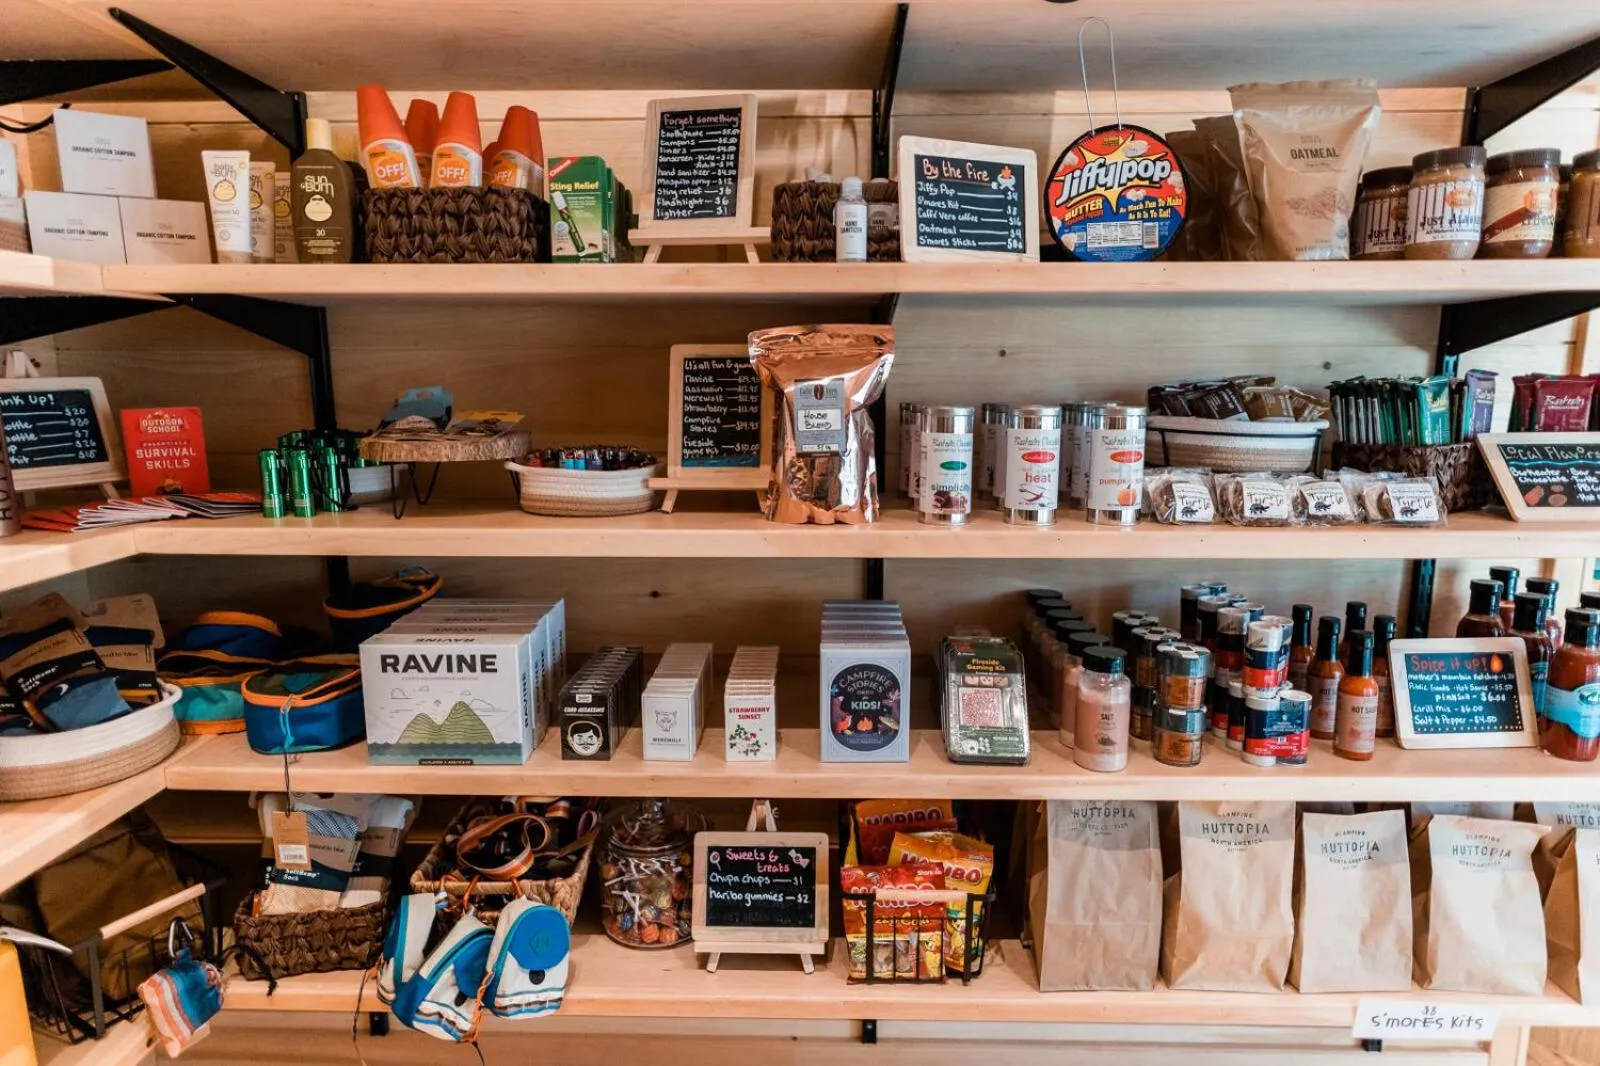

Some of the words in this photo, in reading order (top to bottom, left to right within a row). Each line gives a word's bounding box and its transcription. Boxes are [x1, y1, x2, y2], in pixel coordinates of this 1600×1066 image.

[1290, 147, 1340, 160] OATMEAL
[376, 161, 405, 178] OFF!
[437, 165, 466, 181] OFF!
[923, 158, 939, 179] By
[942, 160, 963, 178] the
[550, 182, 573, 192] Sting
[574, 181, 599, 190] Relief
[1064, 199, 1103, 222] BUTTER
[919, 223, 957, 235] Oatmeal
[28, 393, 55, 406] Up!
[142, 418, 184, 427] OUTDOOR
[147, 425, 181, 433] SCHOOL
[135, 447, 197, 459] SURVIVAL
[145, 458, 191, 470] SKILLS
[1025, 472, 1052, 484] heat
[380, 653, 499, 674] RAVINE
[1410, 655, 1447, 673] Spice
[839, 670, 893, 688] CAMPFIRE
[847, 680, 885, 694] STORIES
[851, 701, 881, 710] KIDS!
[1100, 713, 1114, 721] SALT
[1071, 806, 1137, 819] HUTTOPIA
[1201, 822, 1271, 835] HUTTOPIA
[1211, 838, 1232, 846] NORTH
[1233, 838, 1263, 847] AMERICA
[1320, 839, 1380, 854] HUTTOPIA
[726, 848, 766, 861] Sweets
[1451, 844, 1512, 858] HUTTOPIA
[756, 861, 790, 873] treats
[743, 892, 784, 907] gummies
[1449, 1014, 1485, 1030] Kits
